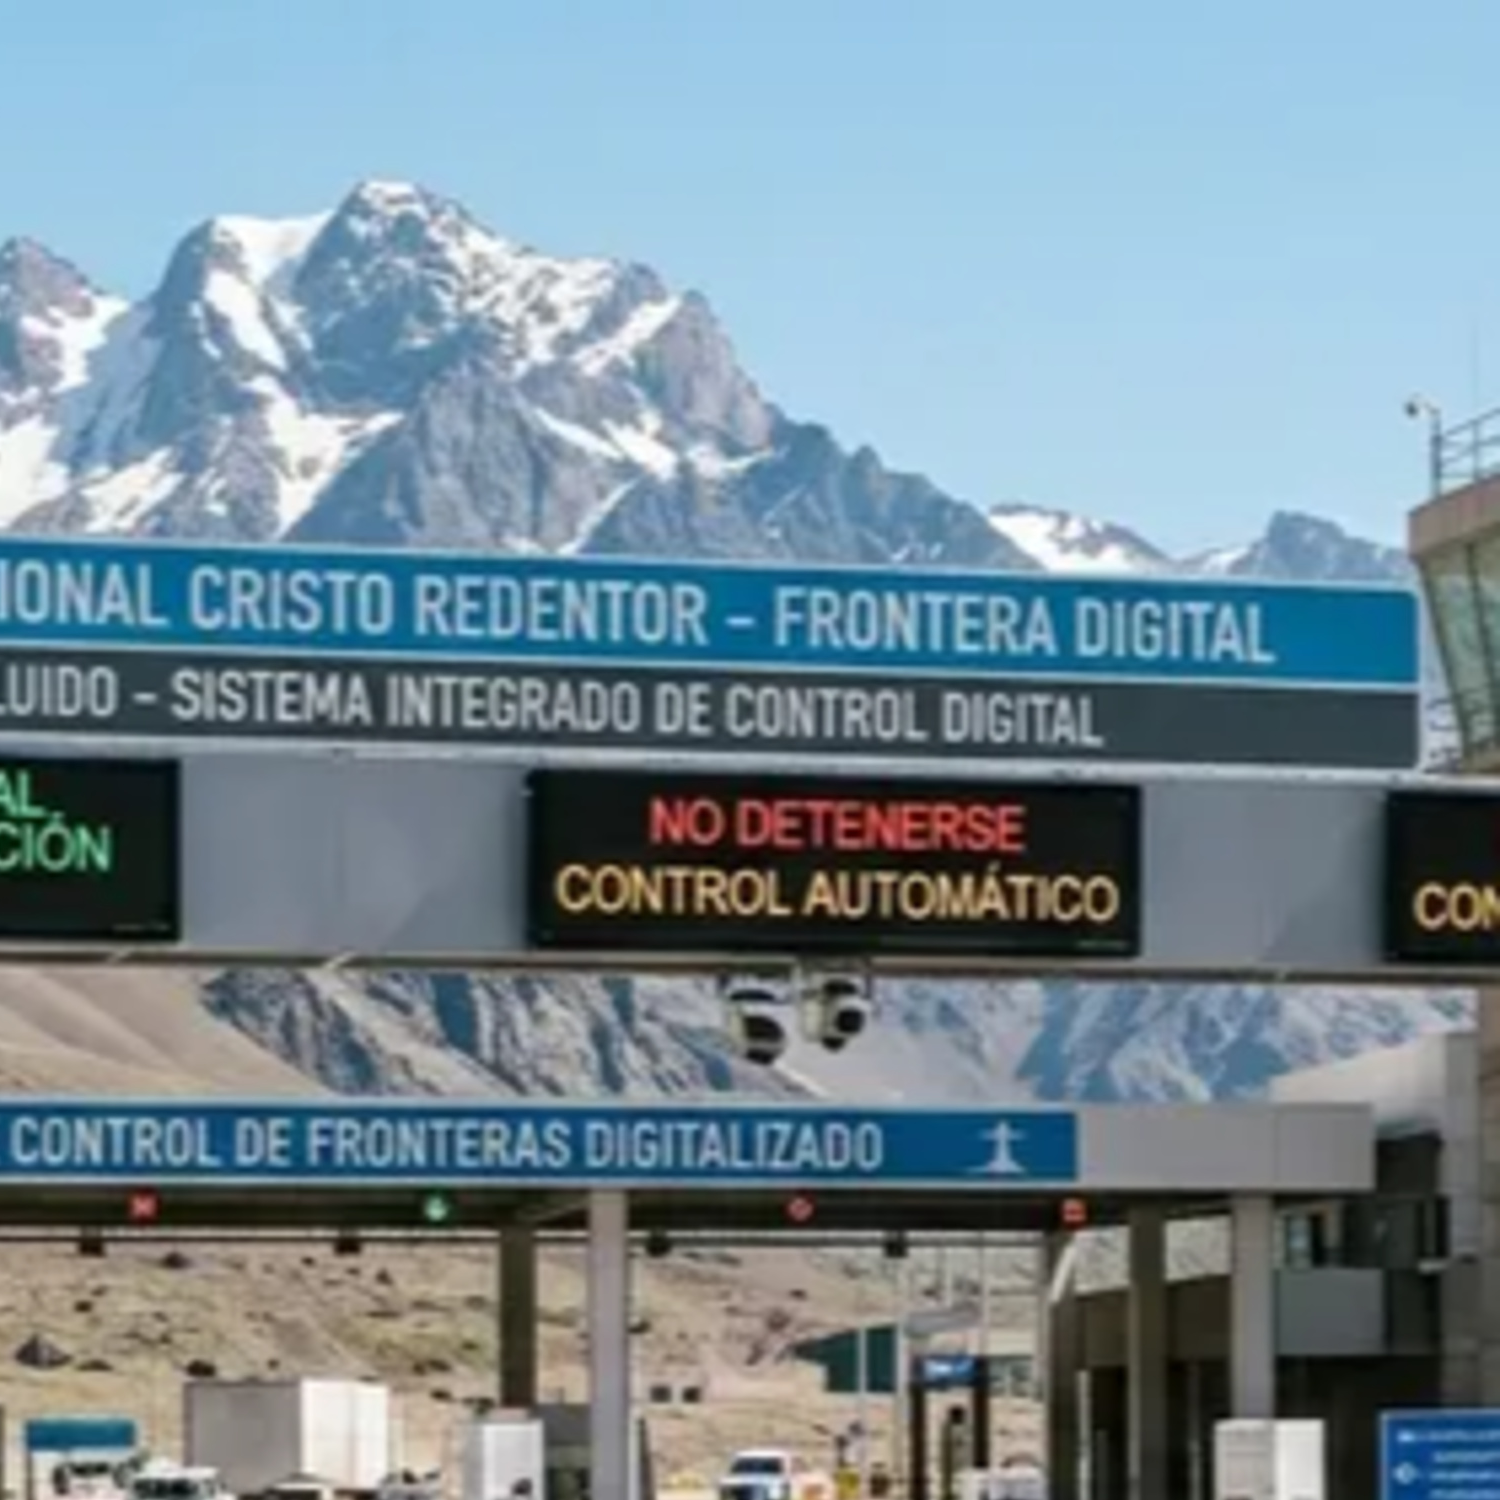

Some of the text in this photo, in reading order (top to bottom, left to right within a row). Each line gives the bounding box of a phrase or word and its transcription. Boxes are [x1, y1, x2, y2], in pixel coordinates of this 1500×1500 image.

[192, 567, 393, 635] CRISTO
[417, 575, 706, 645] REDENTOR
[778, 588, 1055, 656] FRONTERA
[1078, 600, 1274, 664] DIGITAL
[172, 669, 372, 723] SISTEMA
[389, 676, 639, 732] INTEGRADO
[656, 683, 710, 735] DE
[727, 685, 927, 740] CONTROL
[944, 692, 1103, 747] DIGITAL
[651, 798, 1024, 852] NO DETENERSE
[555, 862, 1120, 923] CONTROL AUTOMÁTICO
[12, 1117, 220, 1166] CONTROL
[236, 1118, 290, 1166] DE
[308, 1118, 571, 1168] FRONTERAS
[586, 1122, 884, 1170] DIGITALIZADO
